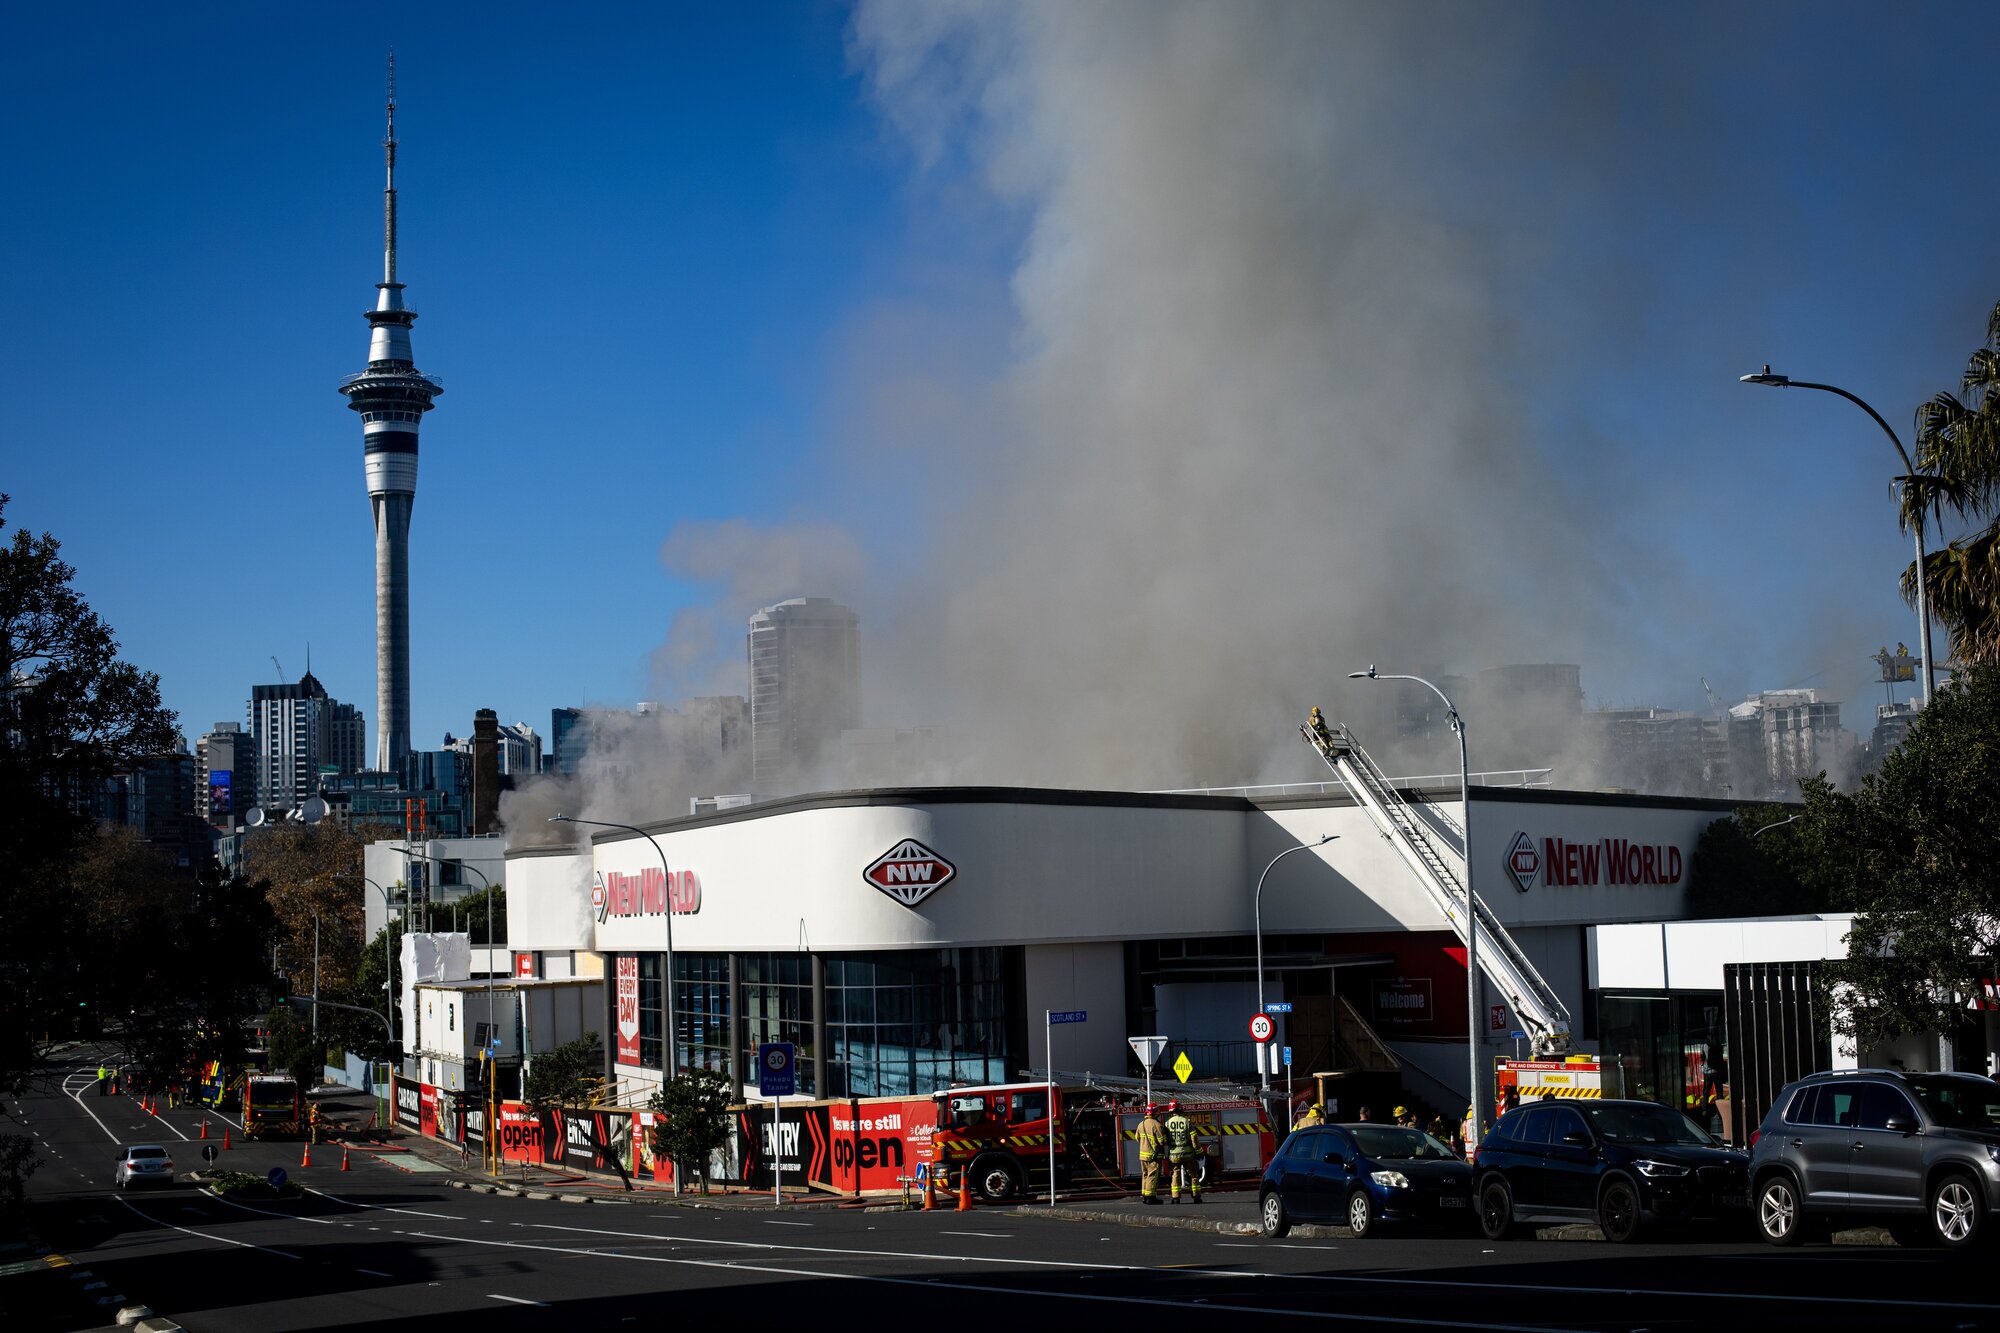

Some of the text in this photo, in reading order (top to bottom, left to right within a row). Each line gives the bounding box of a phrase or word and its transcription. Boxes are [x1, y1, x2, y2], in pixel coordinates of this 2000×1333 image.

[1517, 854, 1535, 870] NW
[1546, 838, 1682, 886] NEW WORLD
[887, 863, 934, 882] NW
[608, 872, 642, 915] NEW
[641, 868, 697, 914] WORLD
[619, 957, 636, 977] SAVE
[620, 979, 635, 994] EVERY
[620, 996, 636, 1023] DAY
[1379, 991, 1425, 1009] Welcome
[1051, 1012, 1081, 1023] SCOTLAND ST
[1255, 1022, 1268, 1033] 30
[770, 1055, 784, 1065] 30
[407, 1089, 419, 1112] PARK
[466, 1111, 483, 1131] ENTRY
[501, 1110, 511, 1121] Yes
[832, 1116, 843, 1131] Yes
[851, 1119, 873, 1132] are
[875, 1114, 901, 1131] still
[1170, 1121, 1185, 1129] OIC
[1190, 1112, 1211, 1125] CUE
[503, 1125, 540, 1152] open
[567, 1117, 592, 1147] ENTRY
[761, 1122, 800, 1156] ENTRY
[834, 1137, 904, 1178] open
